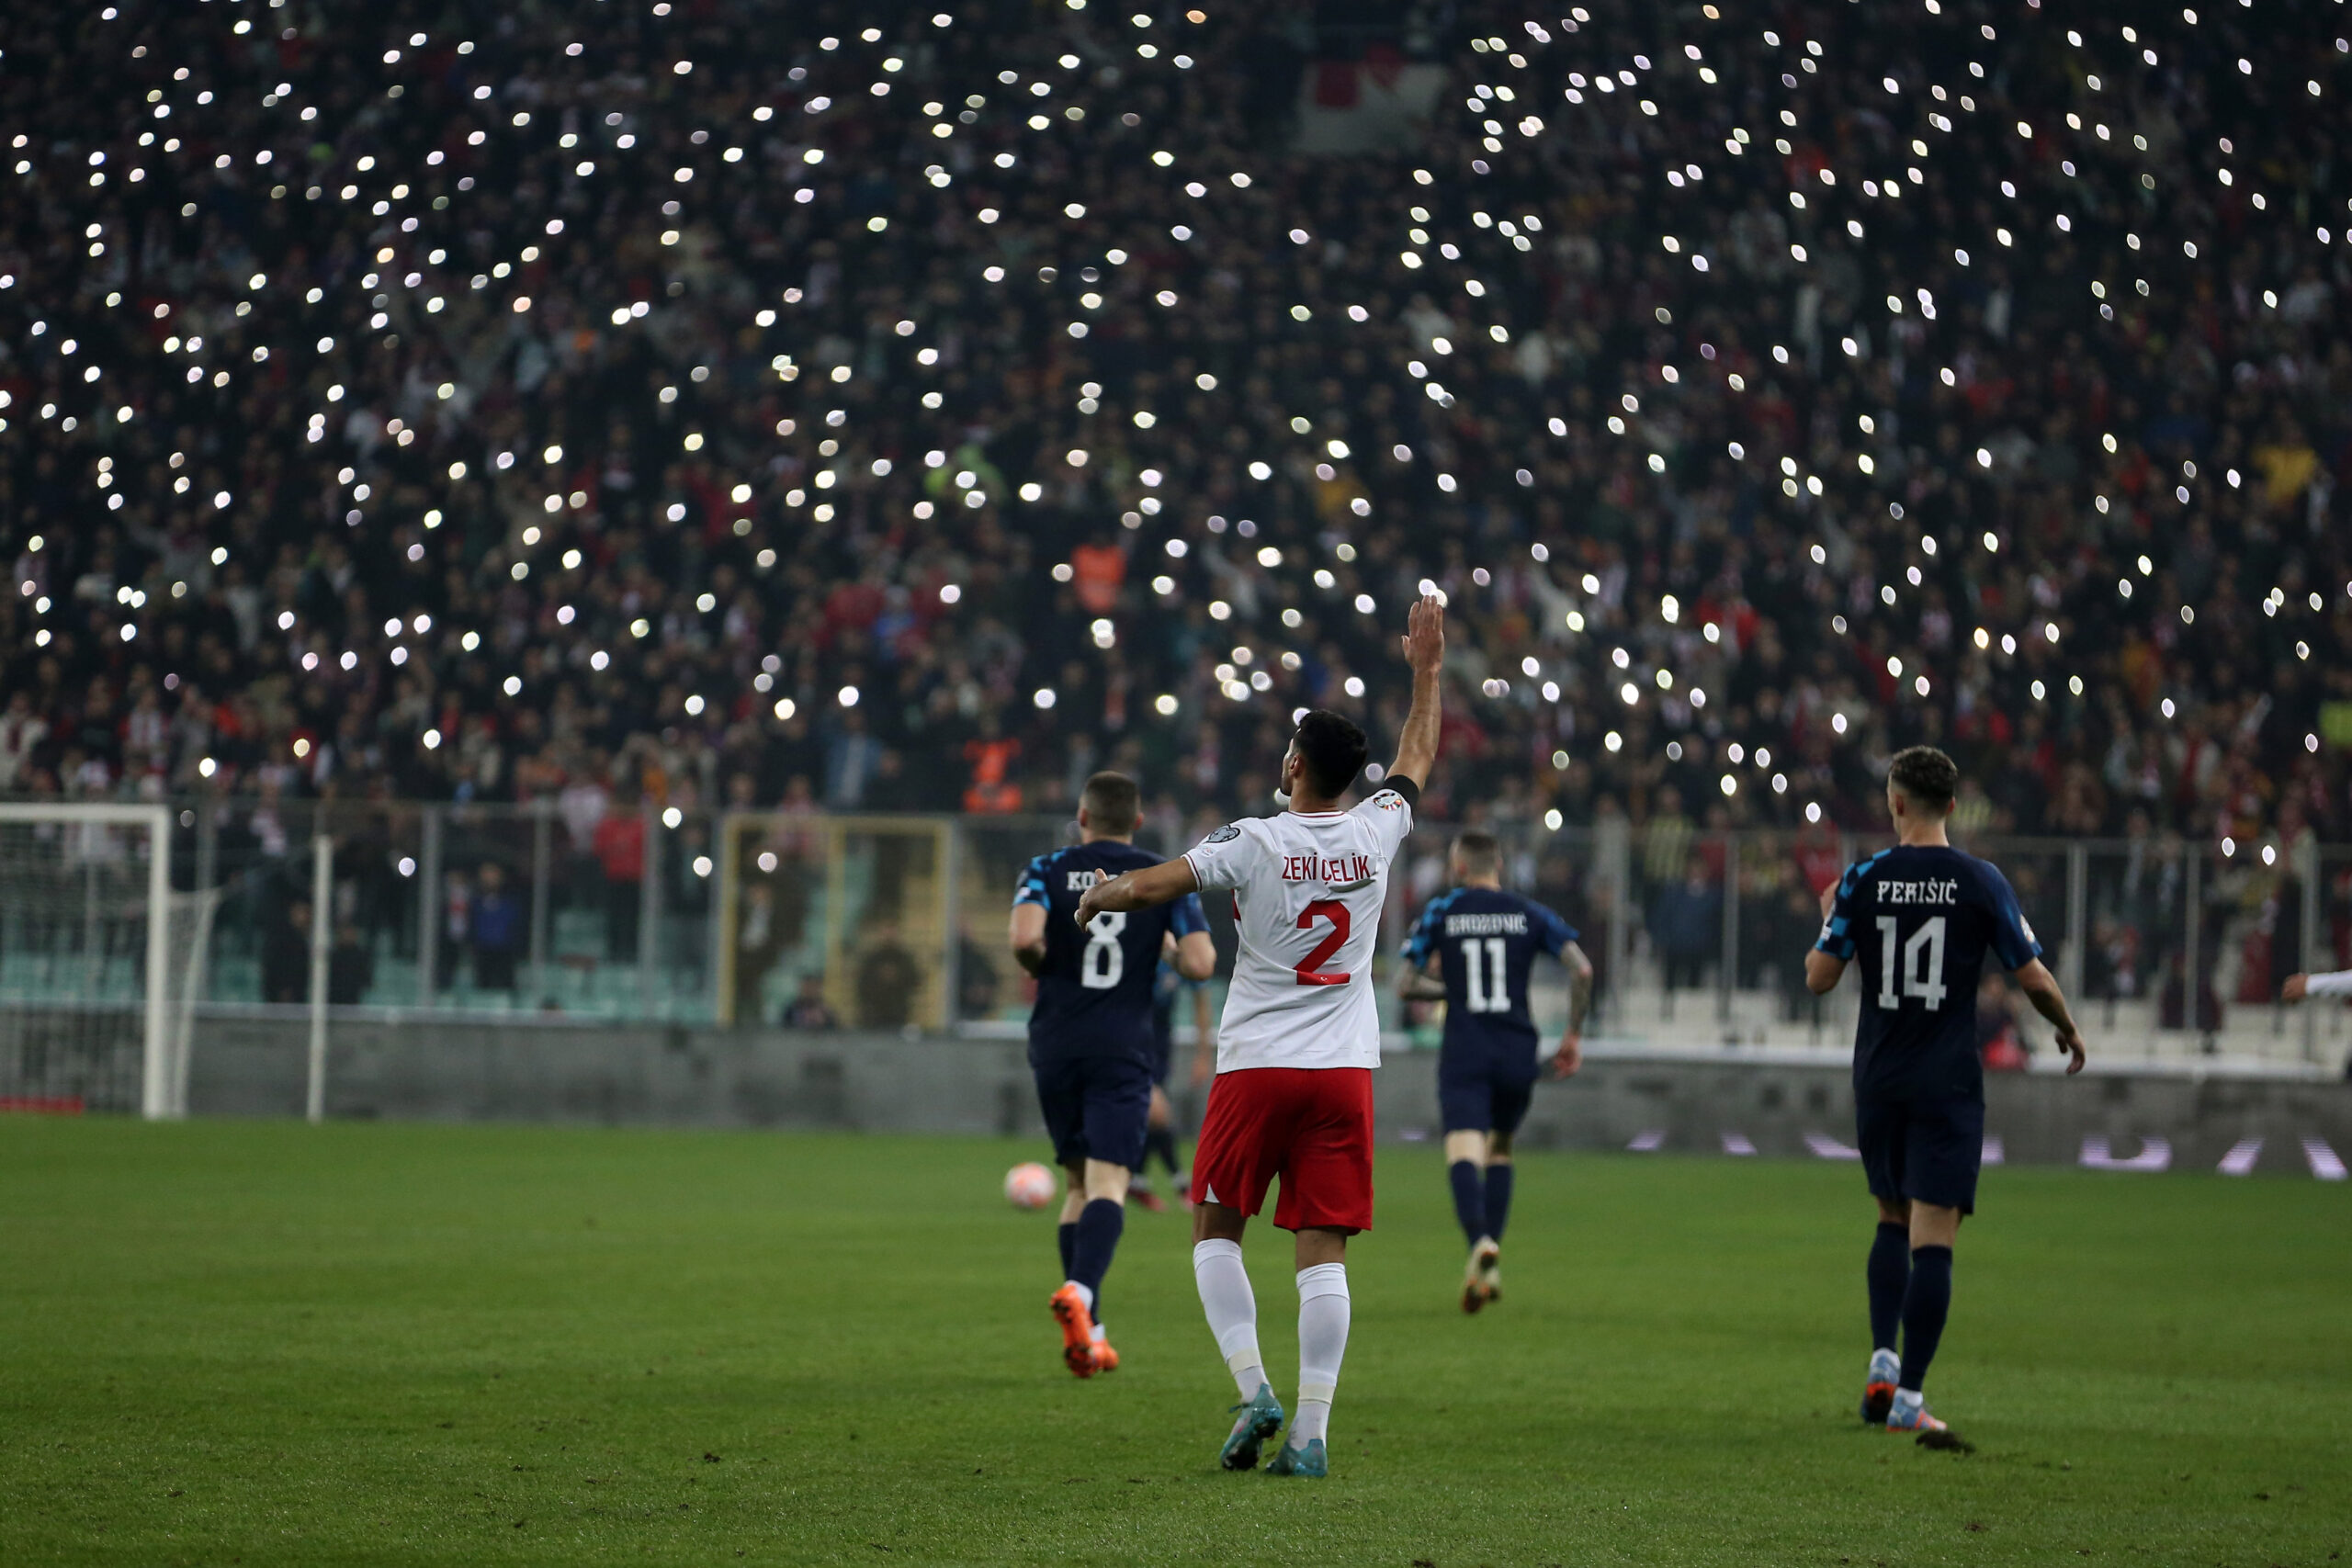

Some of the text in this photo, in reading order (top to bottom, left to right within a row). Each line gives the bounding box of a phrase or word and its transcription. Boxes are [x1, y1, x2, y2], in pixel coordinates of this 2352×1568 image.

[1282, 852, 1371, 886] ZEKİ ÇELİK
[1081, 910, 1126, 989] 8
[1293, 900, 1351, 986] 2
[1461, 938, 1511, 1012] 11
[1875, 916, 1947, 1011] 14
